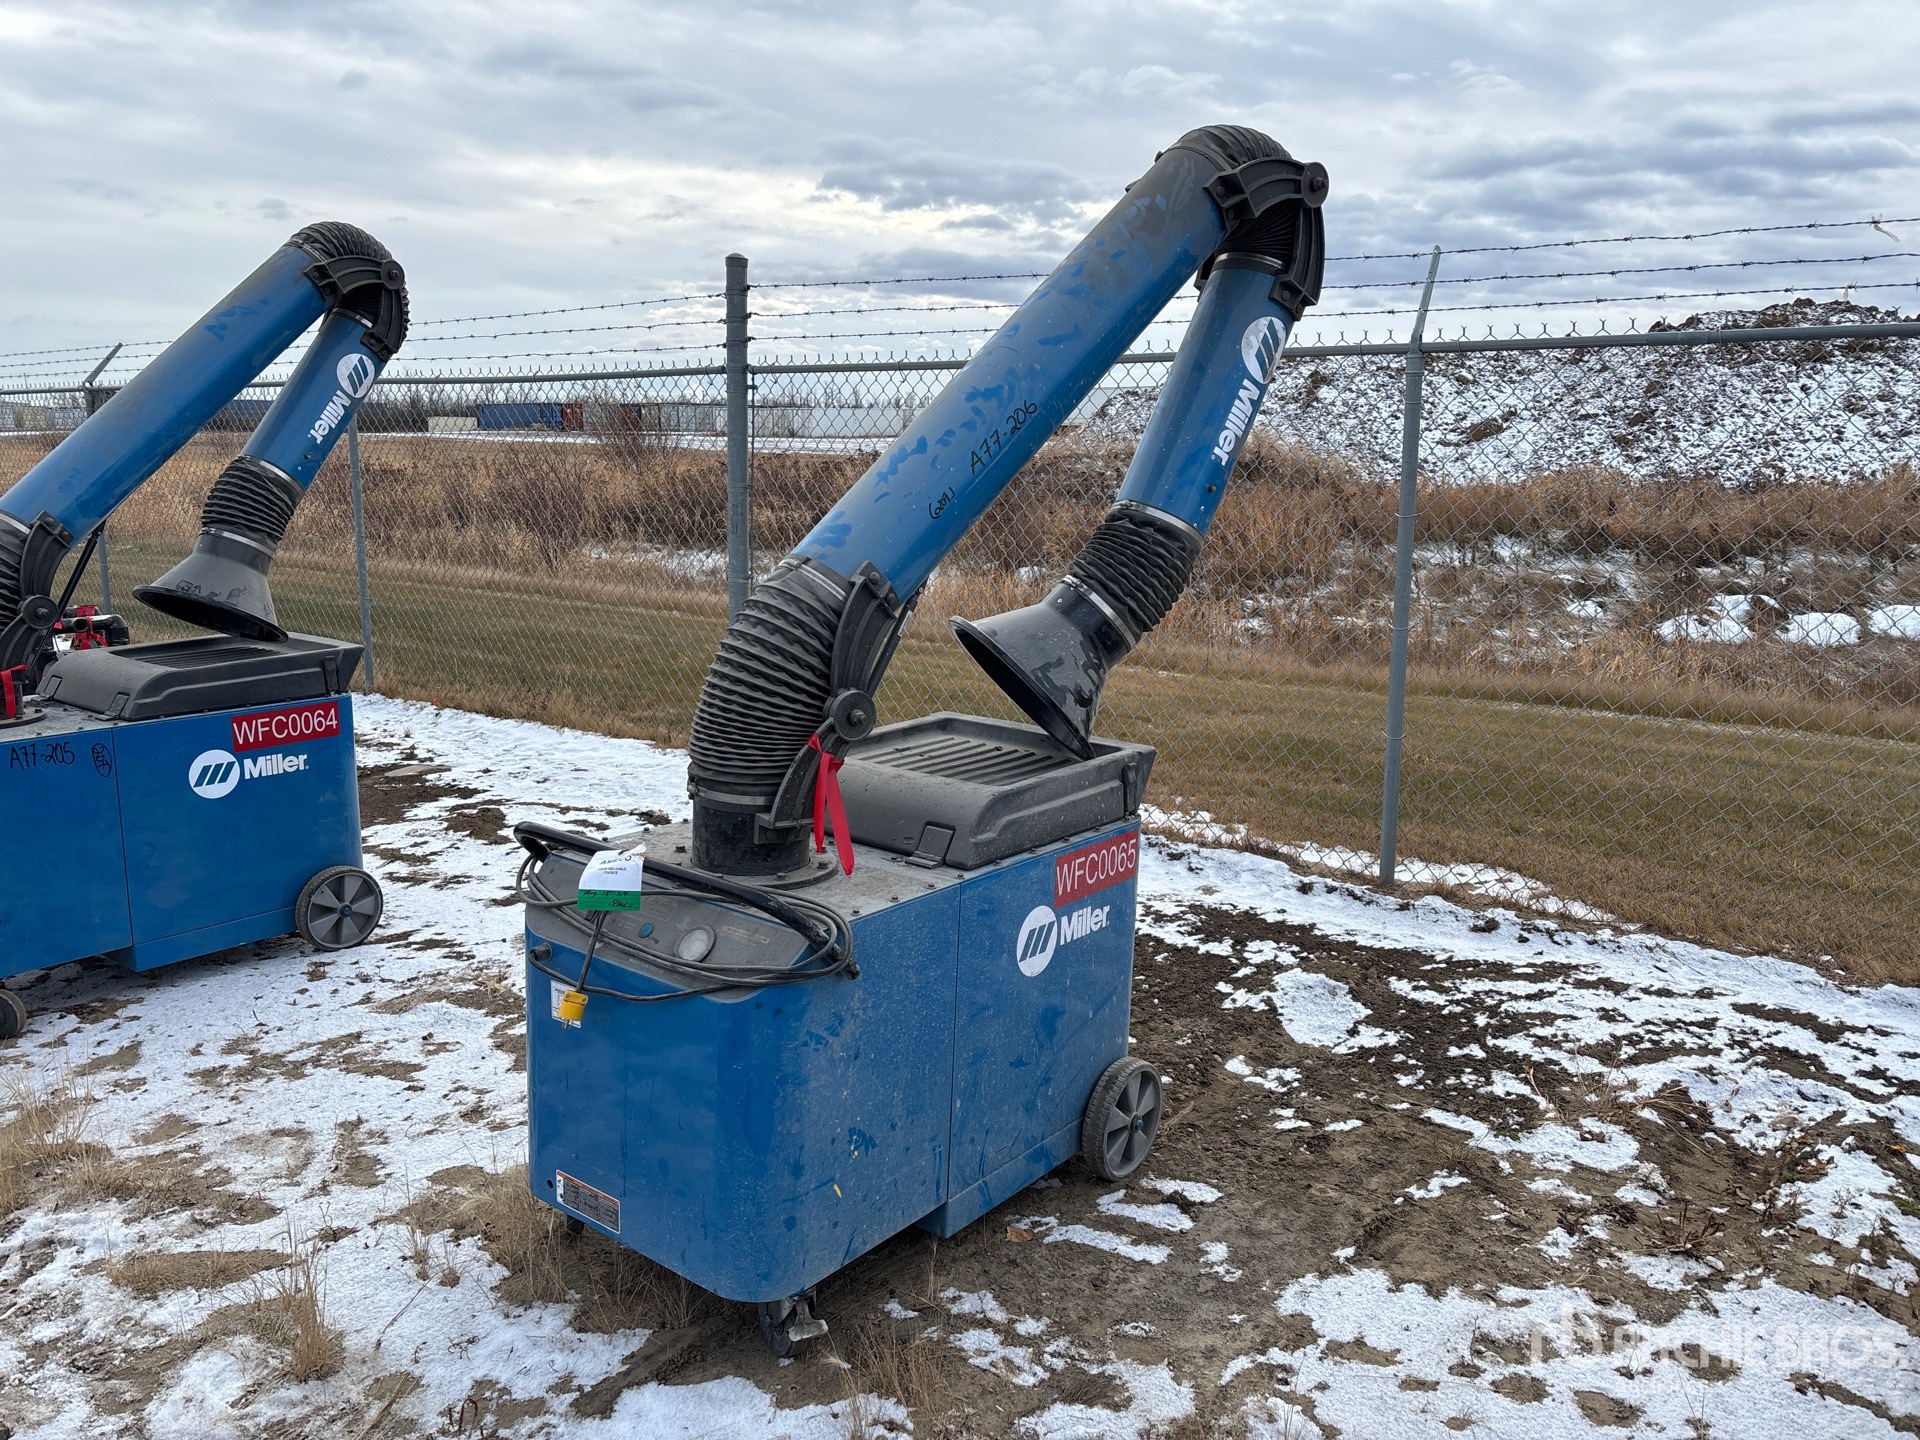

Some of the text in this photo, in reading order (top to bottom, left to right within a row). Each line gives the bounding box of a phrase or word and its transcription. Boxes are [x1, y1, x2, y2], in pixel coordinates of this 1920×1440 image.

[309, 389, 352, 445] Miller
[970, 400, 1037, 475] A77-206
[1214, 378, 1260, 466] Miller
[233, 708, 338, 745] WFC0064
[10, 742, 75, 769] A77-205
[244, 753, 308, 779] Miller
[1056, 838, 1136, 896] WFC0065
[1060, 905, 1110, 945] Miller
